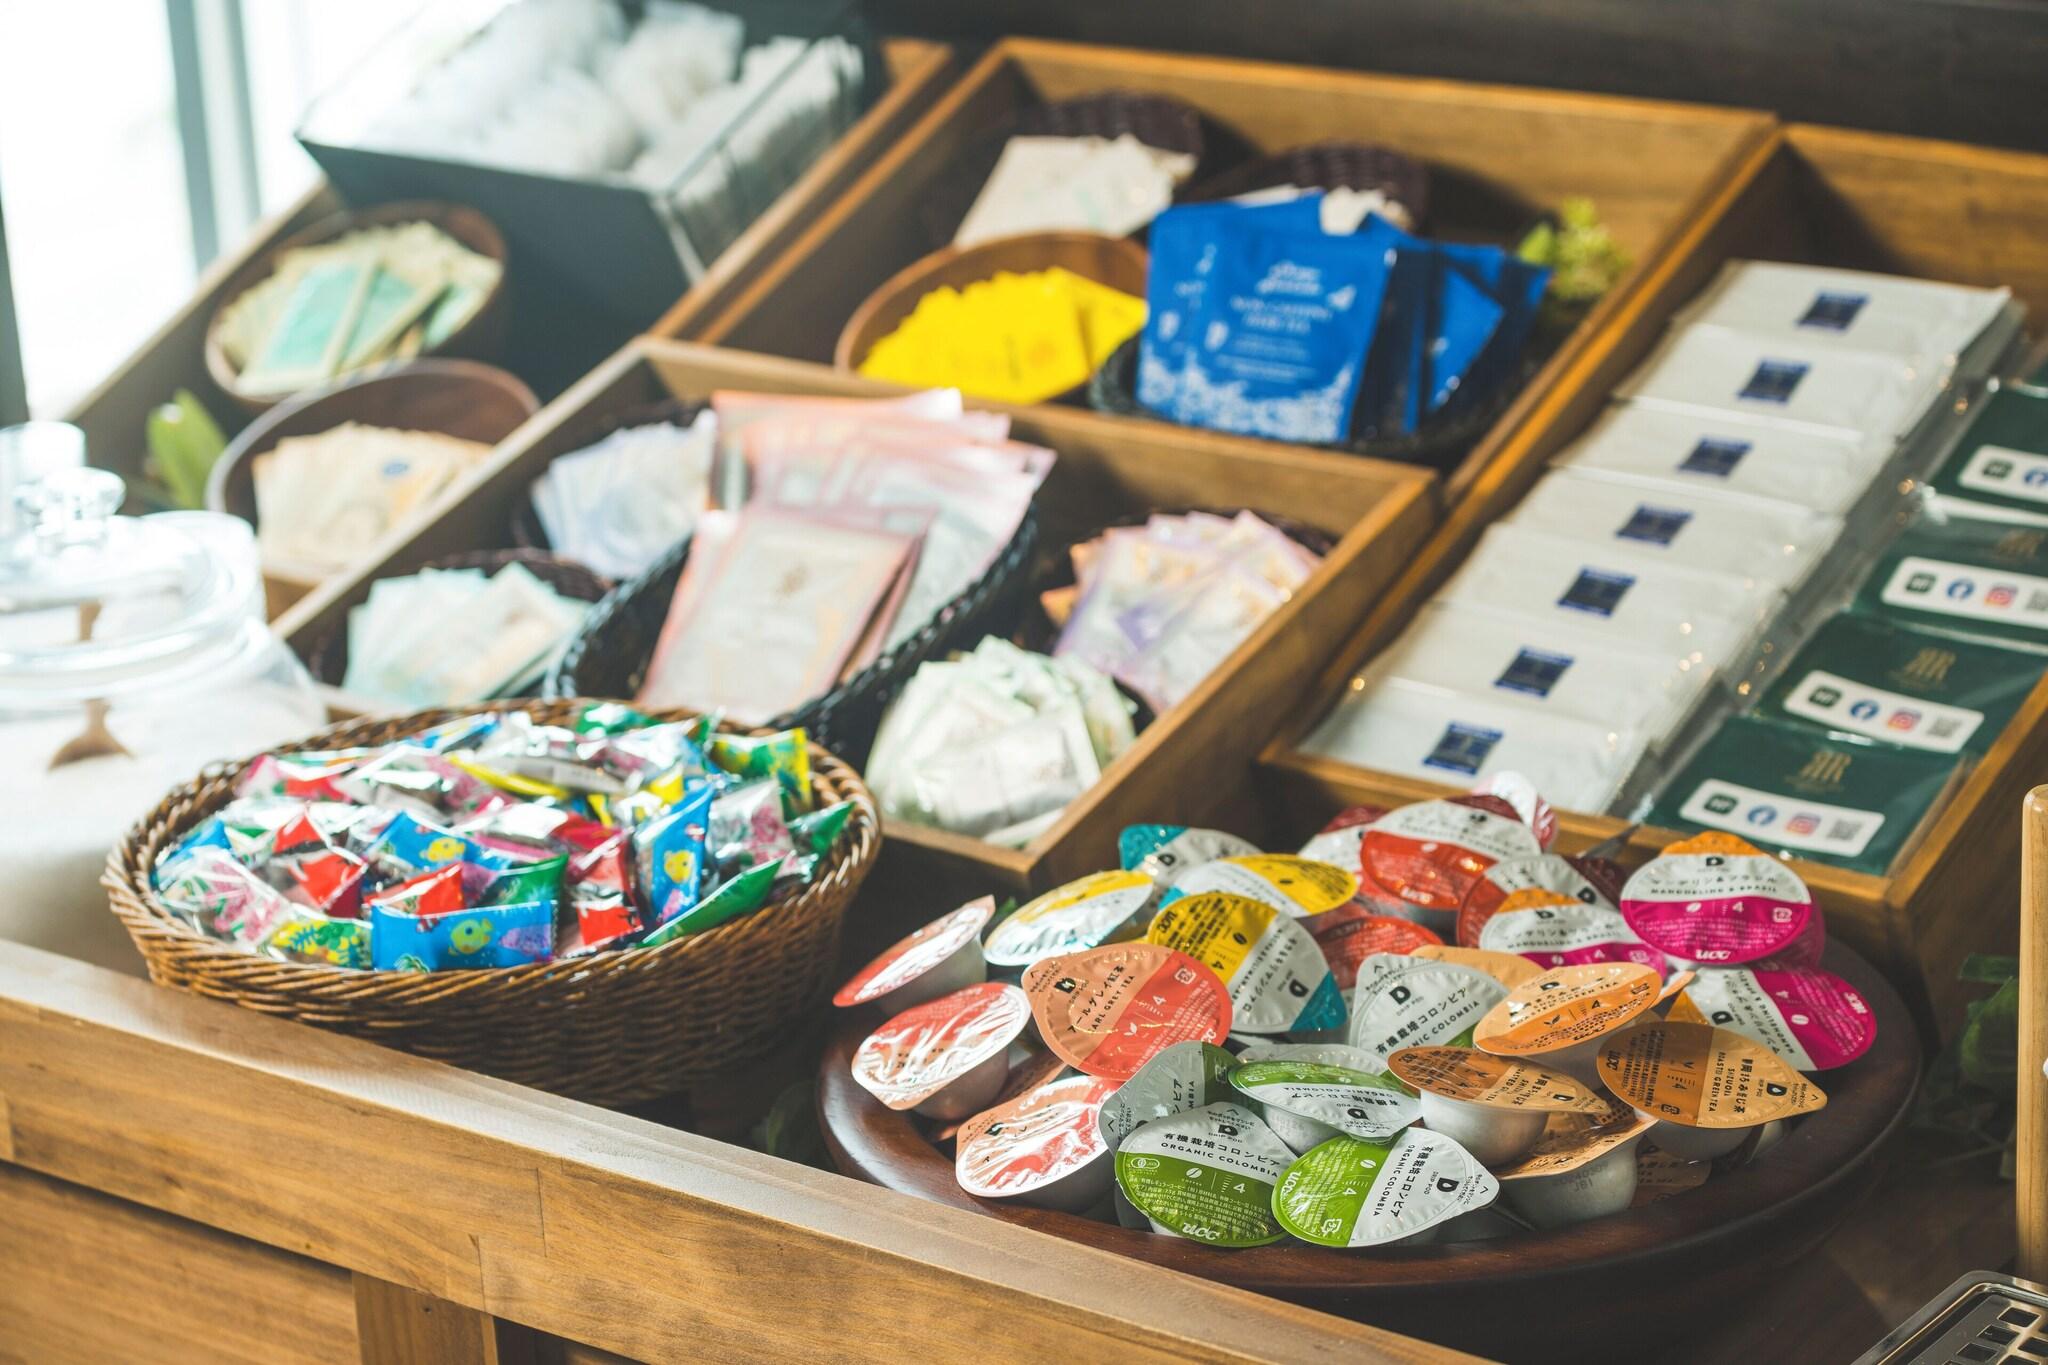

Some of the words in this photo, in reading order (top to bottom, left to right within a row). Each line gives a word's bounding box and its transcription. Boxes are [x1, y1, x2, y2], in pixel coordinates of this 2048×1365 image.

[1104, 990, 1122, 1011] GREY
[1431, 1000, 1480, 1035] COLOMBIA
[1375, 987, 1467, 1054] 有機栽培コロンビア
[1161, 1142, 1214, 1159] ORGANIC
[1219, 1155, 1278, 1178] COLOMBIA
[1164, 1133, 1280, 1167] 有機栽培コロンビア
[1395, 1144, 1416, 1174] ORGANIC
[1233, 1183, 1246, 1194] 4
[1342, 1187, 1357, 1197] 4
[1373, 1176, 1398, 1217] COLOMBIA
[1390, 1145, 1434, 1217] 有機栽培コロンビア
